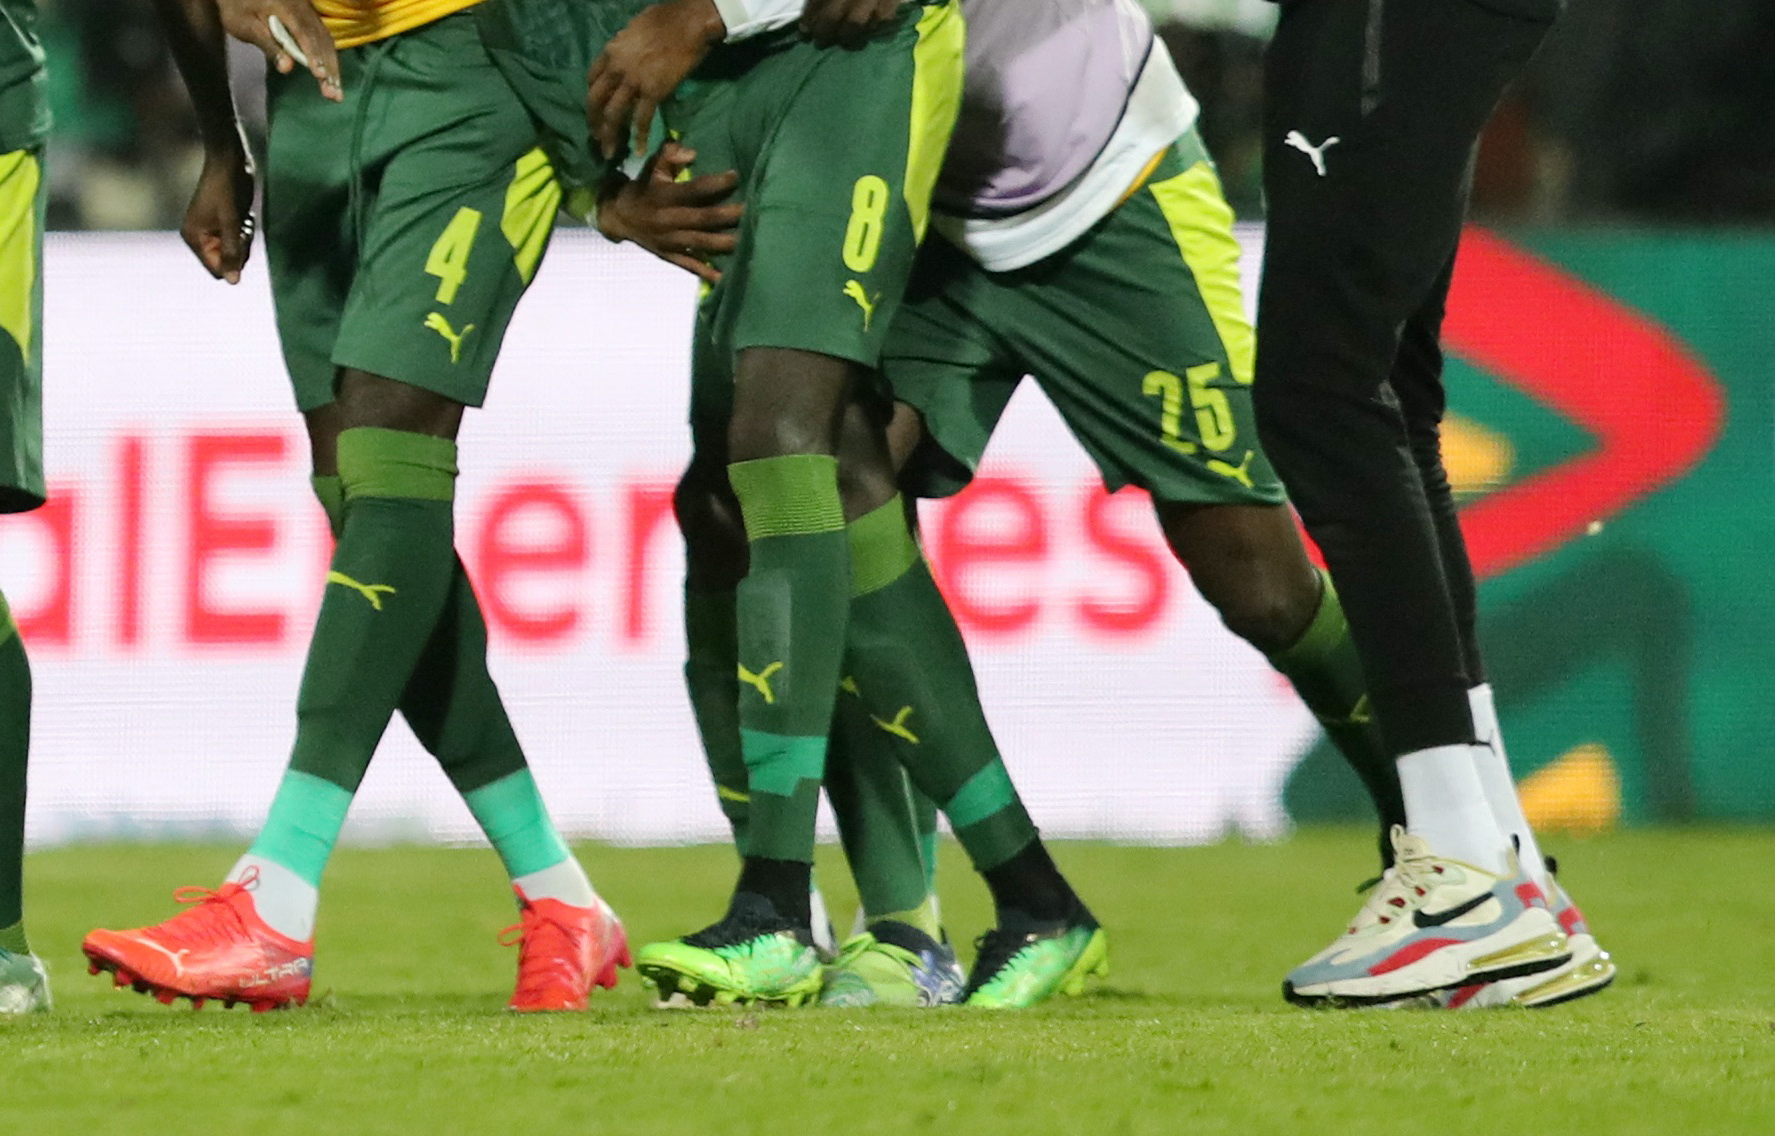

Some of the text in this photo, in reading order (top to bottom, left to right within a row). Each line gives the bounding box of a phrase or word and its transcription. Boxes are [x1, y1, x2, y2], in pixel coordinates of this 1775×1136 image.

[425, 206, 482, 305] 4
[842, 175, 890, 273] 8
[1142, 361, 1236, 455] 25
